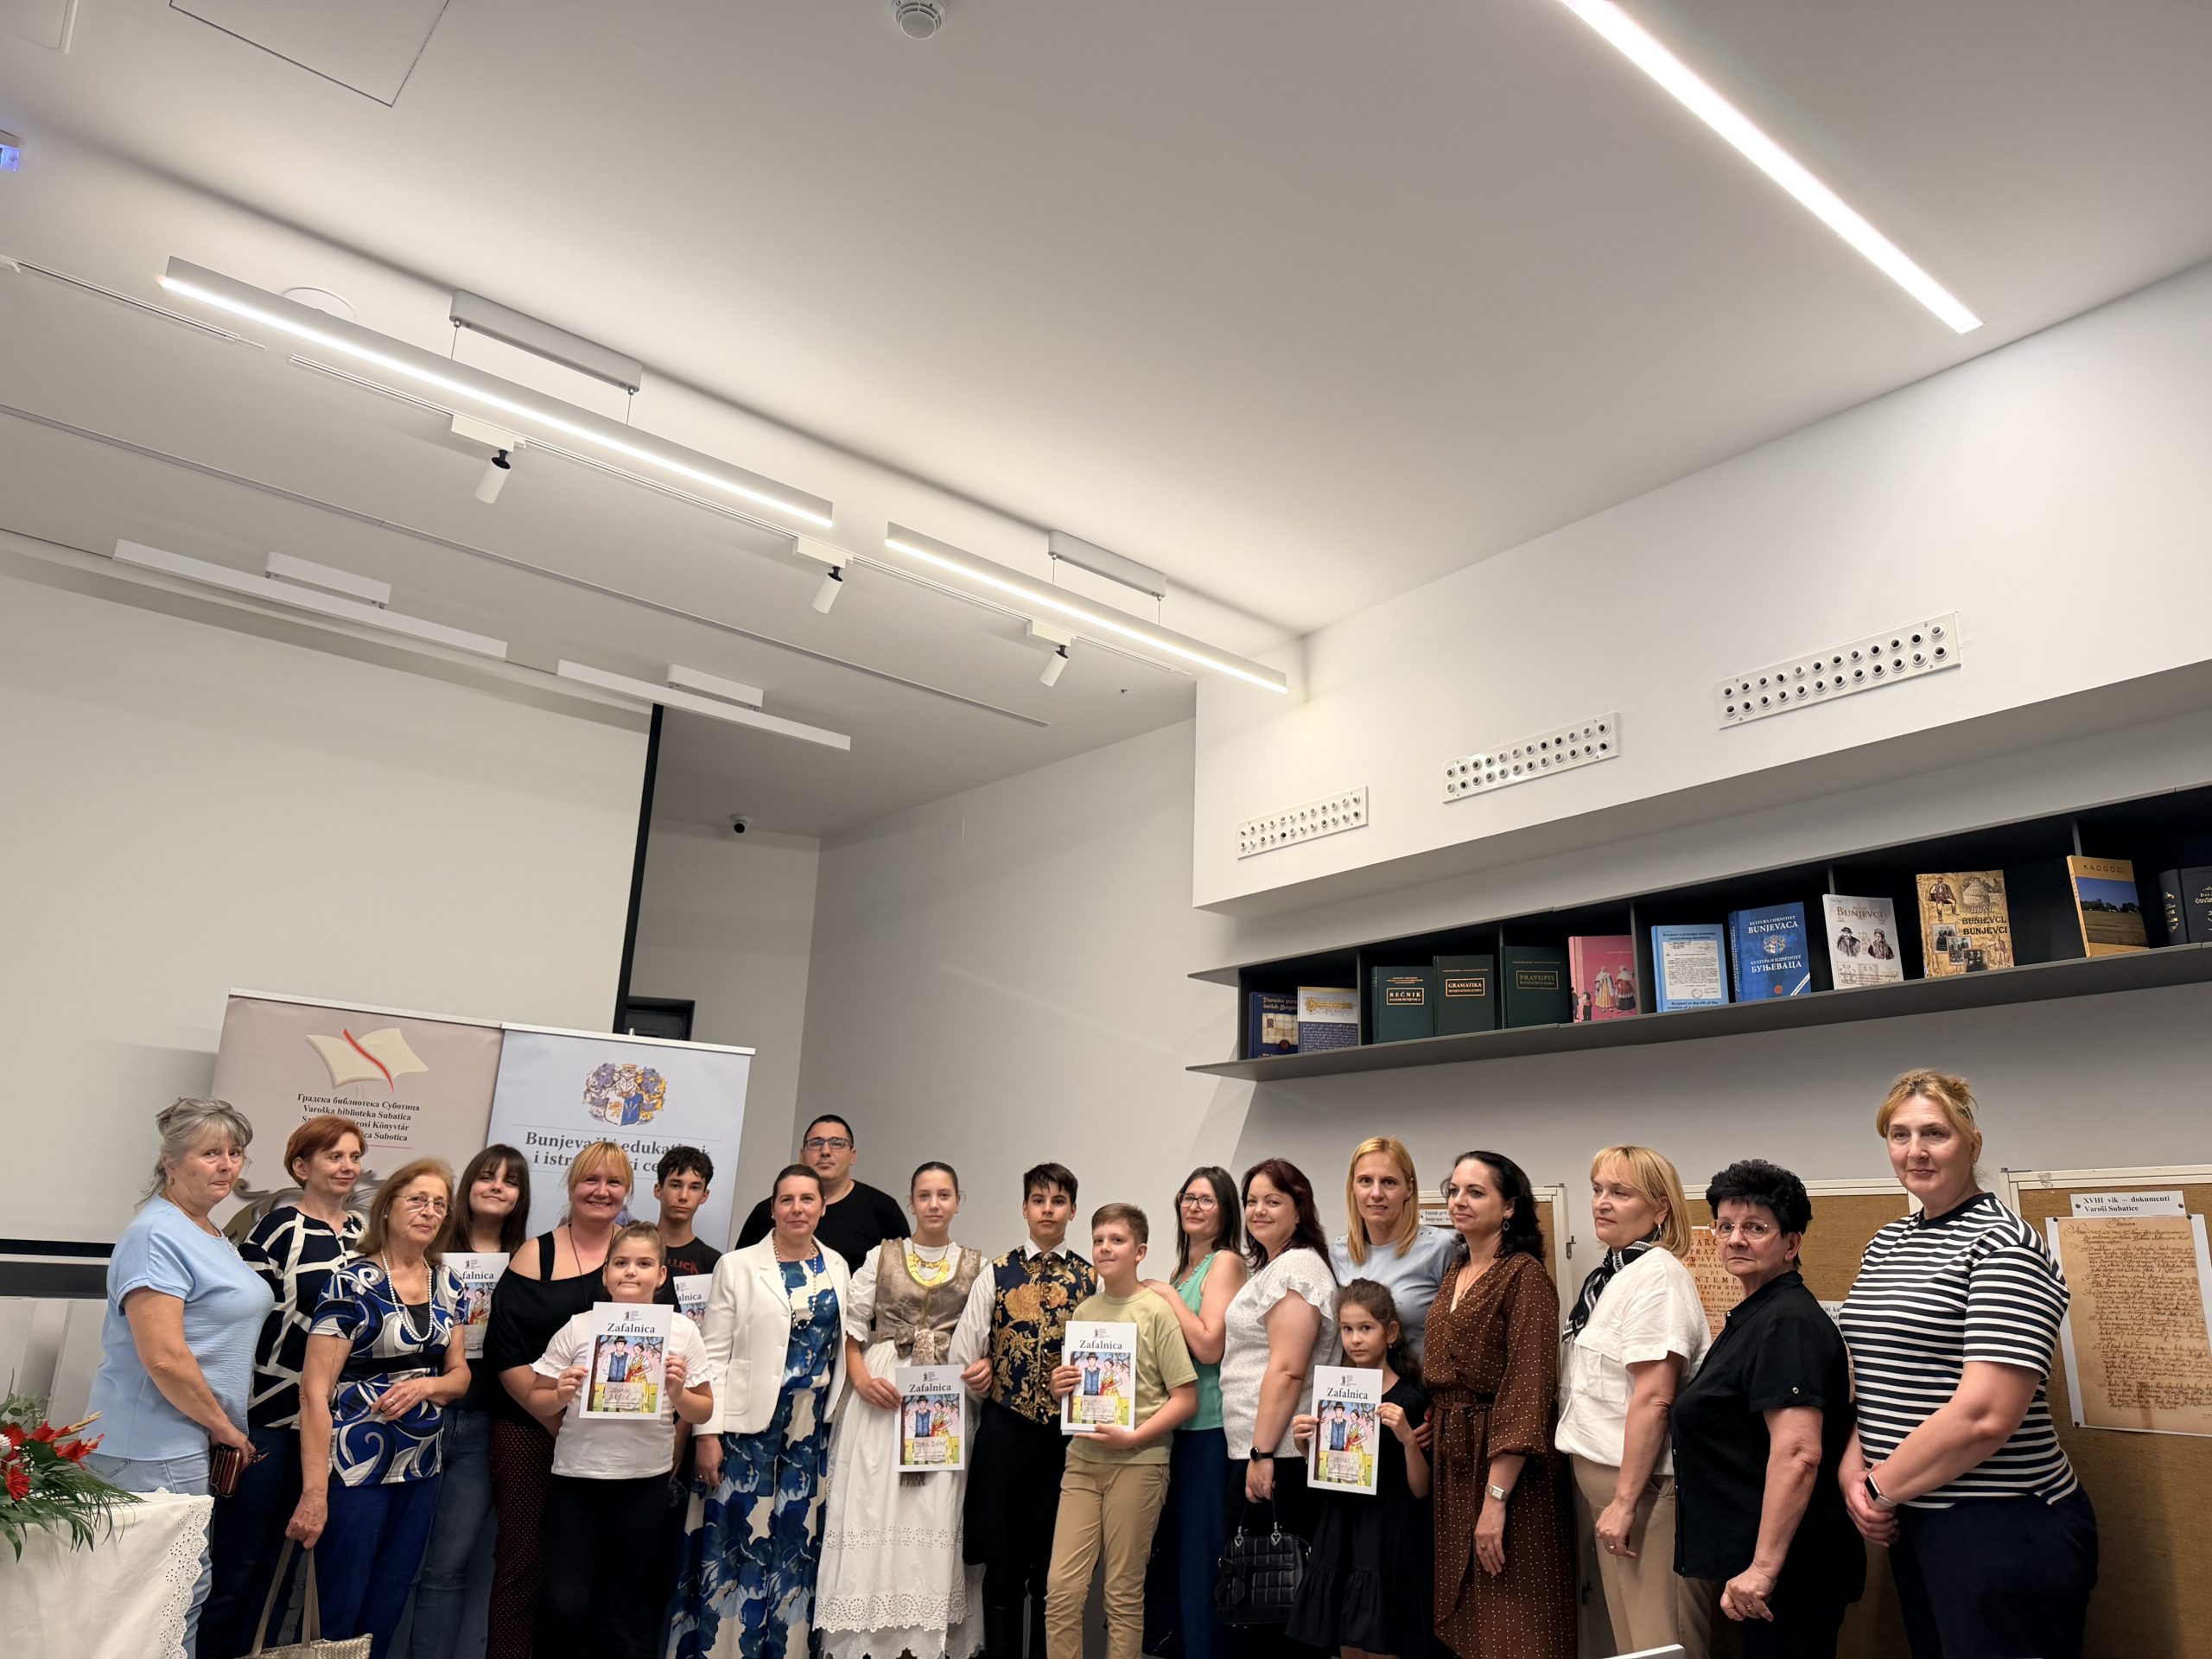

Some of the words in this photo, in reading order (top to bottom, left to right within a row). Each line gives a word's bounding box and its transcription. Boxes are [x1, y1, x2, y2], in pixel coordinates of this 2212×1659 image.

[1748, 921, 1799, 933] BUNJEVACA
[1963, 926, 2008, 935] BUNJEVCI
[1751, 961, 1802, 973] БУЊЕВАЦА
[297, 1093, 330, 1103] Градска
[333, 1097, 379, 1108] библиотека
[382, 1101, 420, 1111] Суботица
[303, 1104, 335, 1115] Varoška
[337, 1108, 376, 1118] biblioteka
[378, 1111, 411, 1121] Subatica
[372, 1121, 410, 1132] Könyvtár
[374, 1132, 408, 1141] Subotica
[533, 1150, 539, 1164] i
[607, 1323, 655, 1333] Zafalnica
[1079, 1339, 1122, 1350] Zafalnica
[909, 1383, 951, 1393] Zafalnica
[1327, 1387, 1369, 1400] Zafalnica
